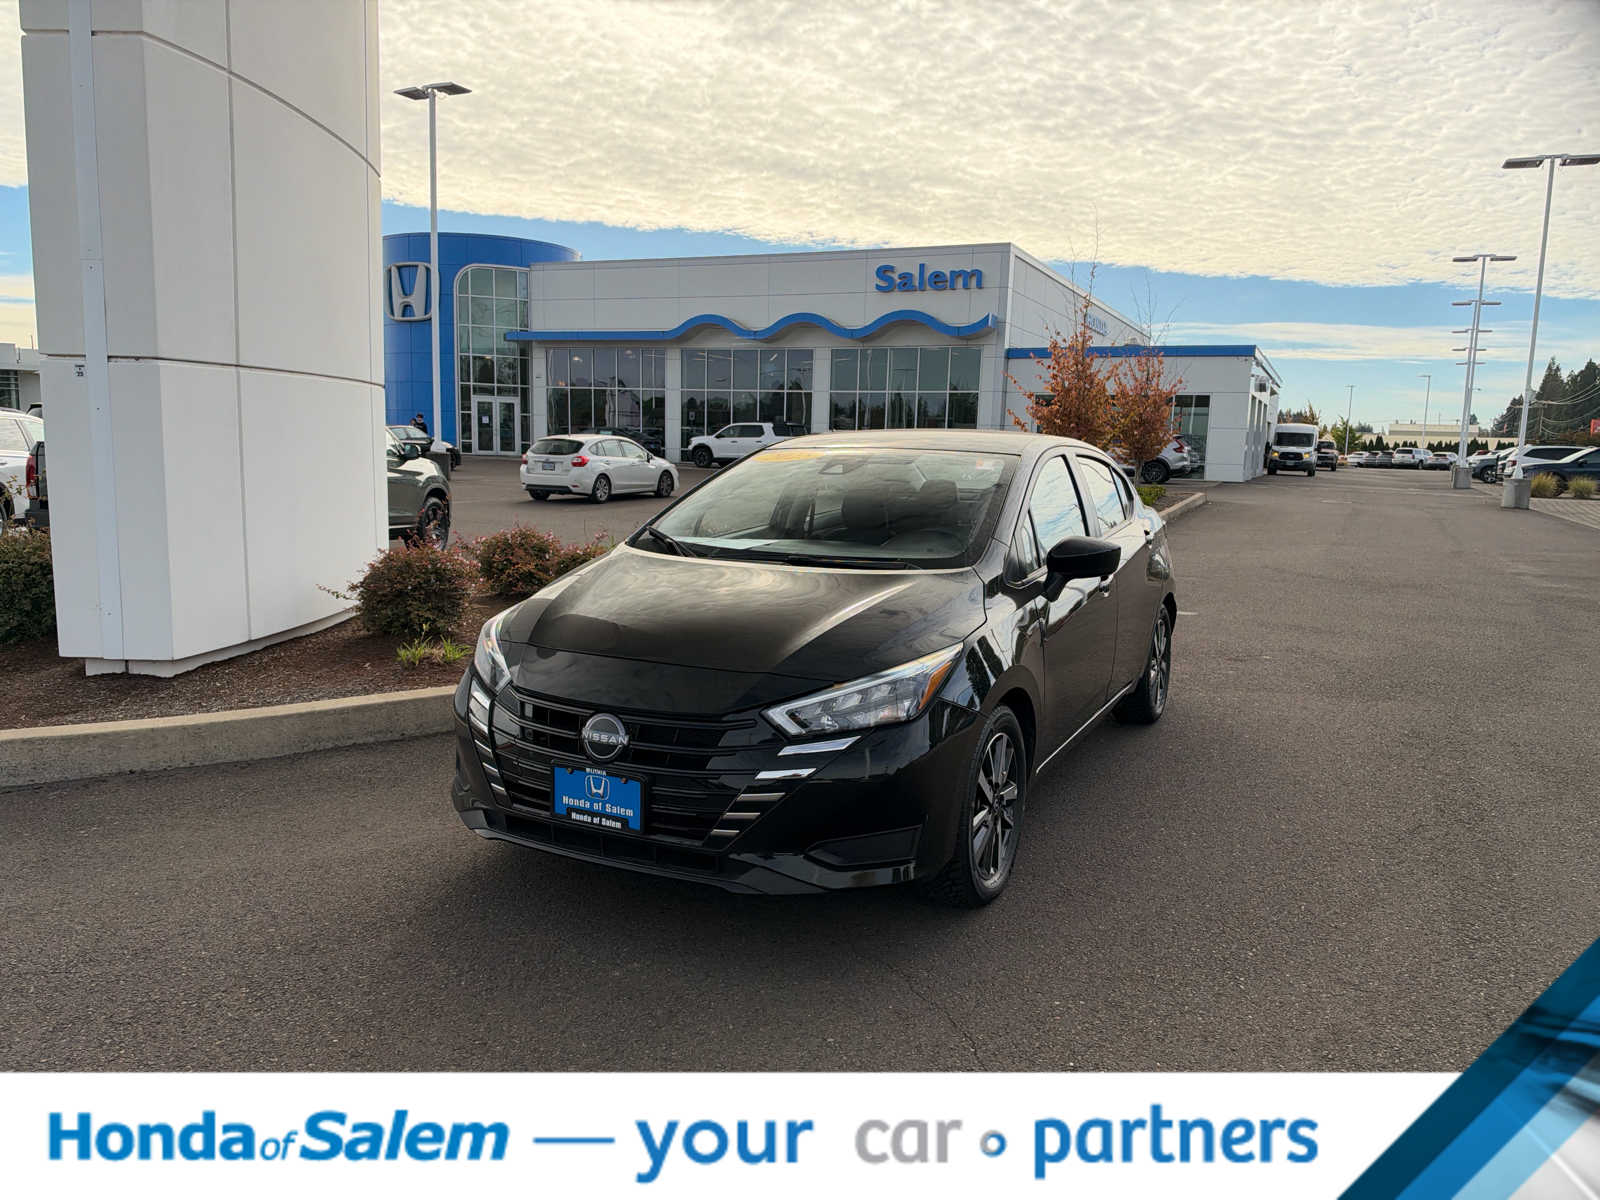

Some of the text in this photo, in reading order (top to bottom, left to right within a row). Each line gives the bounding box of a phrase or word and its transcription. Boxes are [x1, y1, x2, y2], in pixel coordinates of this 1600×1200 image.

[875, 263, 983, 292] Salem
[582, 727, 629, 746] NISSAN
[562, 795, 633, 817] Honda of Salem
[571, 812, 622, 829] Honda of Salem
